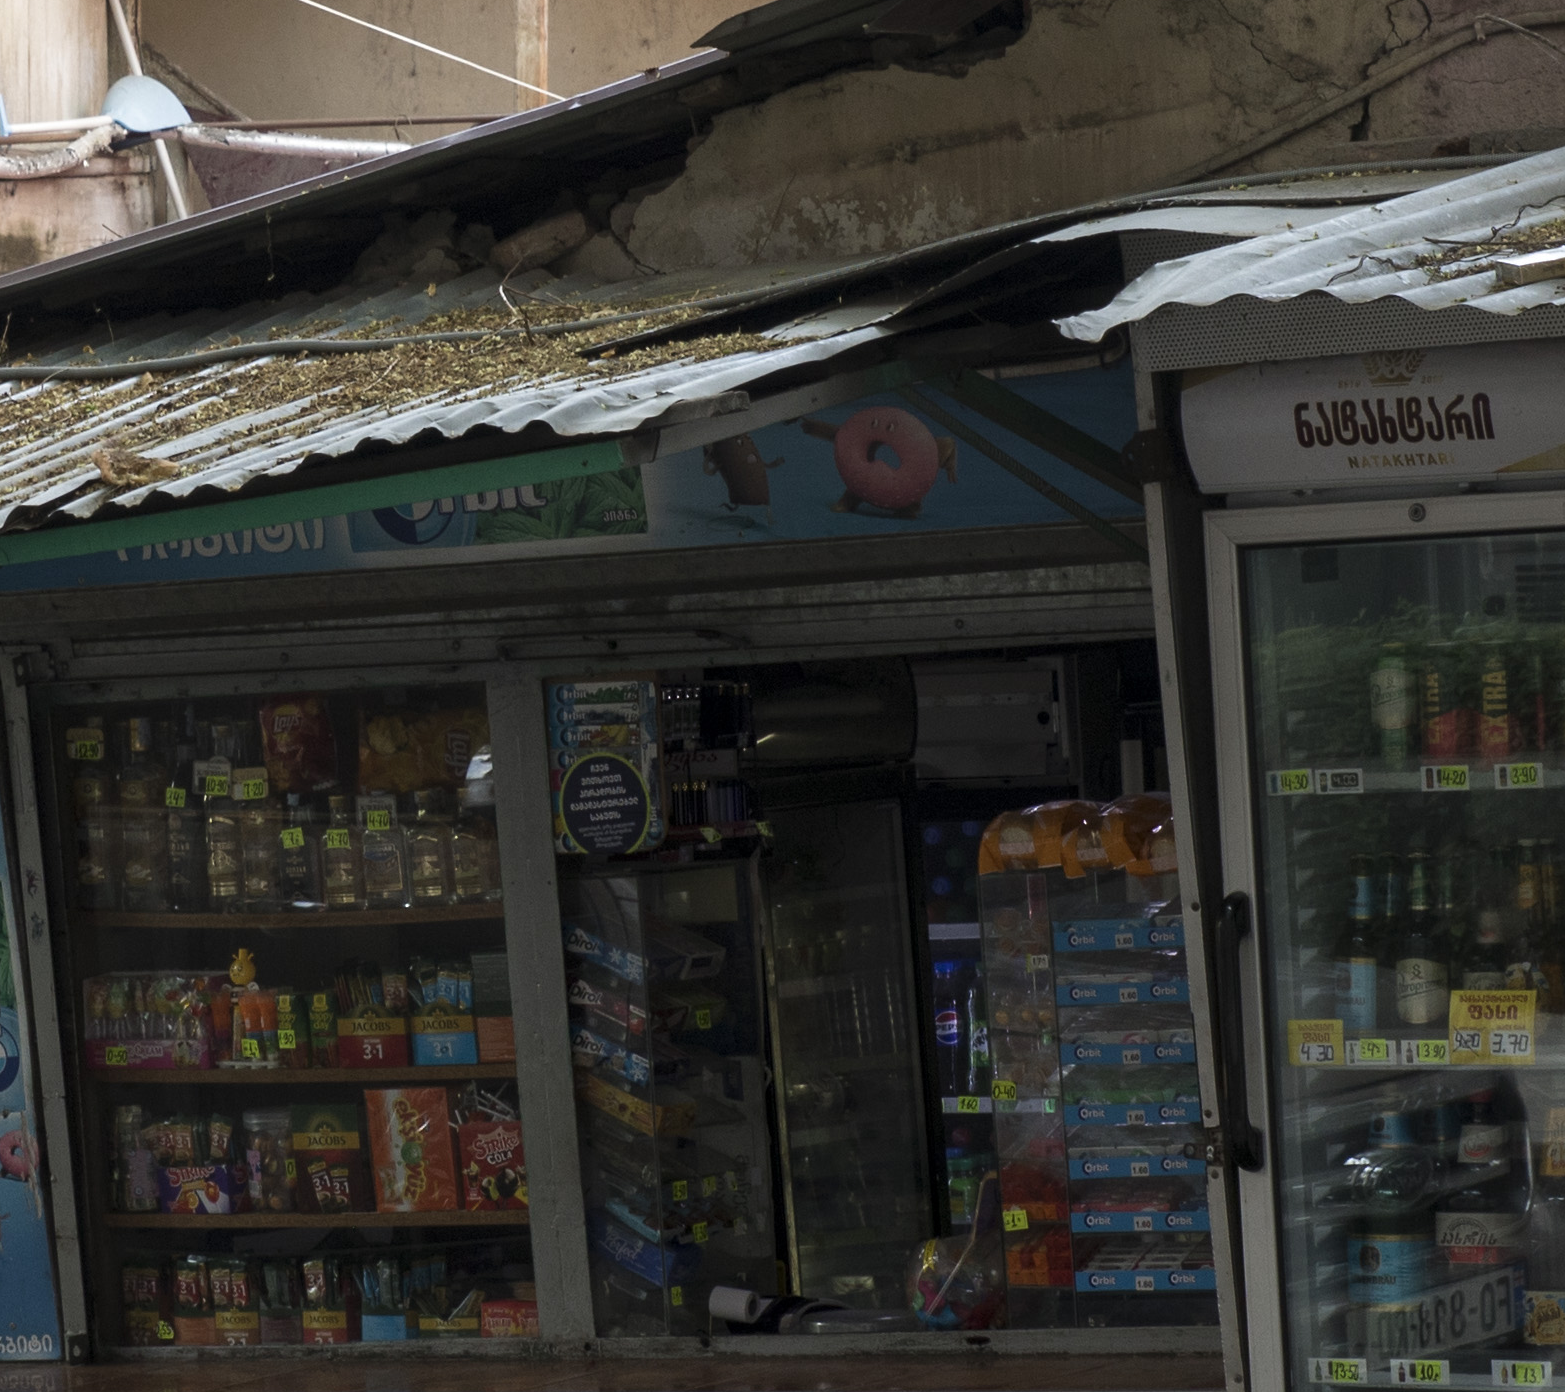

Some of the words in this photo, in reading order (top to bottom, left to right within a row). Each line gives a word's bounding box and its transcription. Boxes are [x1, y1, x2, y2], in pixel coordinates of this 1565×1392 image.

[1294, 392, 1495, 448] ნატახტარი
[1348, 453, 1454, 469] NATAKHTARI
[1069, 933, 1096, 948] Orbit
[1116, 936, 1133, 946] 1.60
[1150, 929, 1176, 945] Orbit
[1072, 986, 1097, 1001] Orbit
[1120, 991, 1137, 1001] 1.60
[1152, 984, 1178, 998] Orbit
[1468, 1004, 1518, 1021] ფასი
[351, 1020, 391, 1032] JACOBS
[421, 1019, 460, 1032] JACOBS
[1076, 1045, 1102, 1060] Orbit
[1123, 1053, 1140, 1063] 1.60
[1155, 1044, 1181, 1059] Orbit
[1079, 1107, 1105, 1120] Orbit
[1128, 1113, 1144, 1122] 1.60
[1160, 1105, 1186, 1120] Orbit
[307, 1136, 346, 1147] JACOBS
[1083, 1160, 1110, 1176] Orbit
[1132, 1166, 1148, 1175] 1.60
[1162, 1158, 1188, 1173] Orbit
[1086, 1213, 1111, 1228] Orbit
[1135, 1219, 1152, 1229] 1.60
[1167, 1213, 1193, 1228] Orbit
[1090, 1272, 1116, 1288] Orbit
[1137, 1280, 1154, 1290] 1.60
[1170, 1271, 1196, 1286] Orbit
[221, 1314, 252, 1325] JACOBS
[308, 1314, 339, 1325] JACOBS
